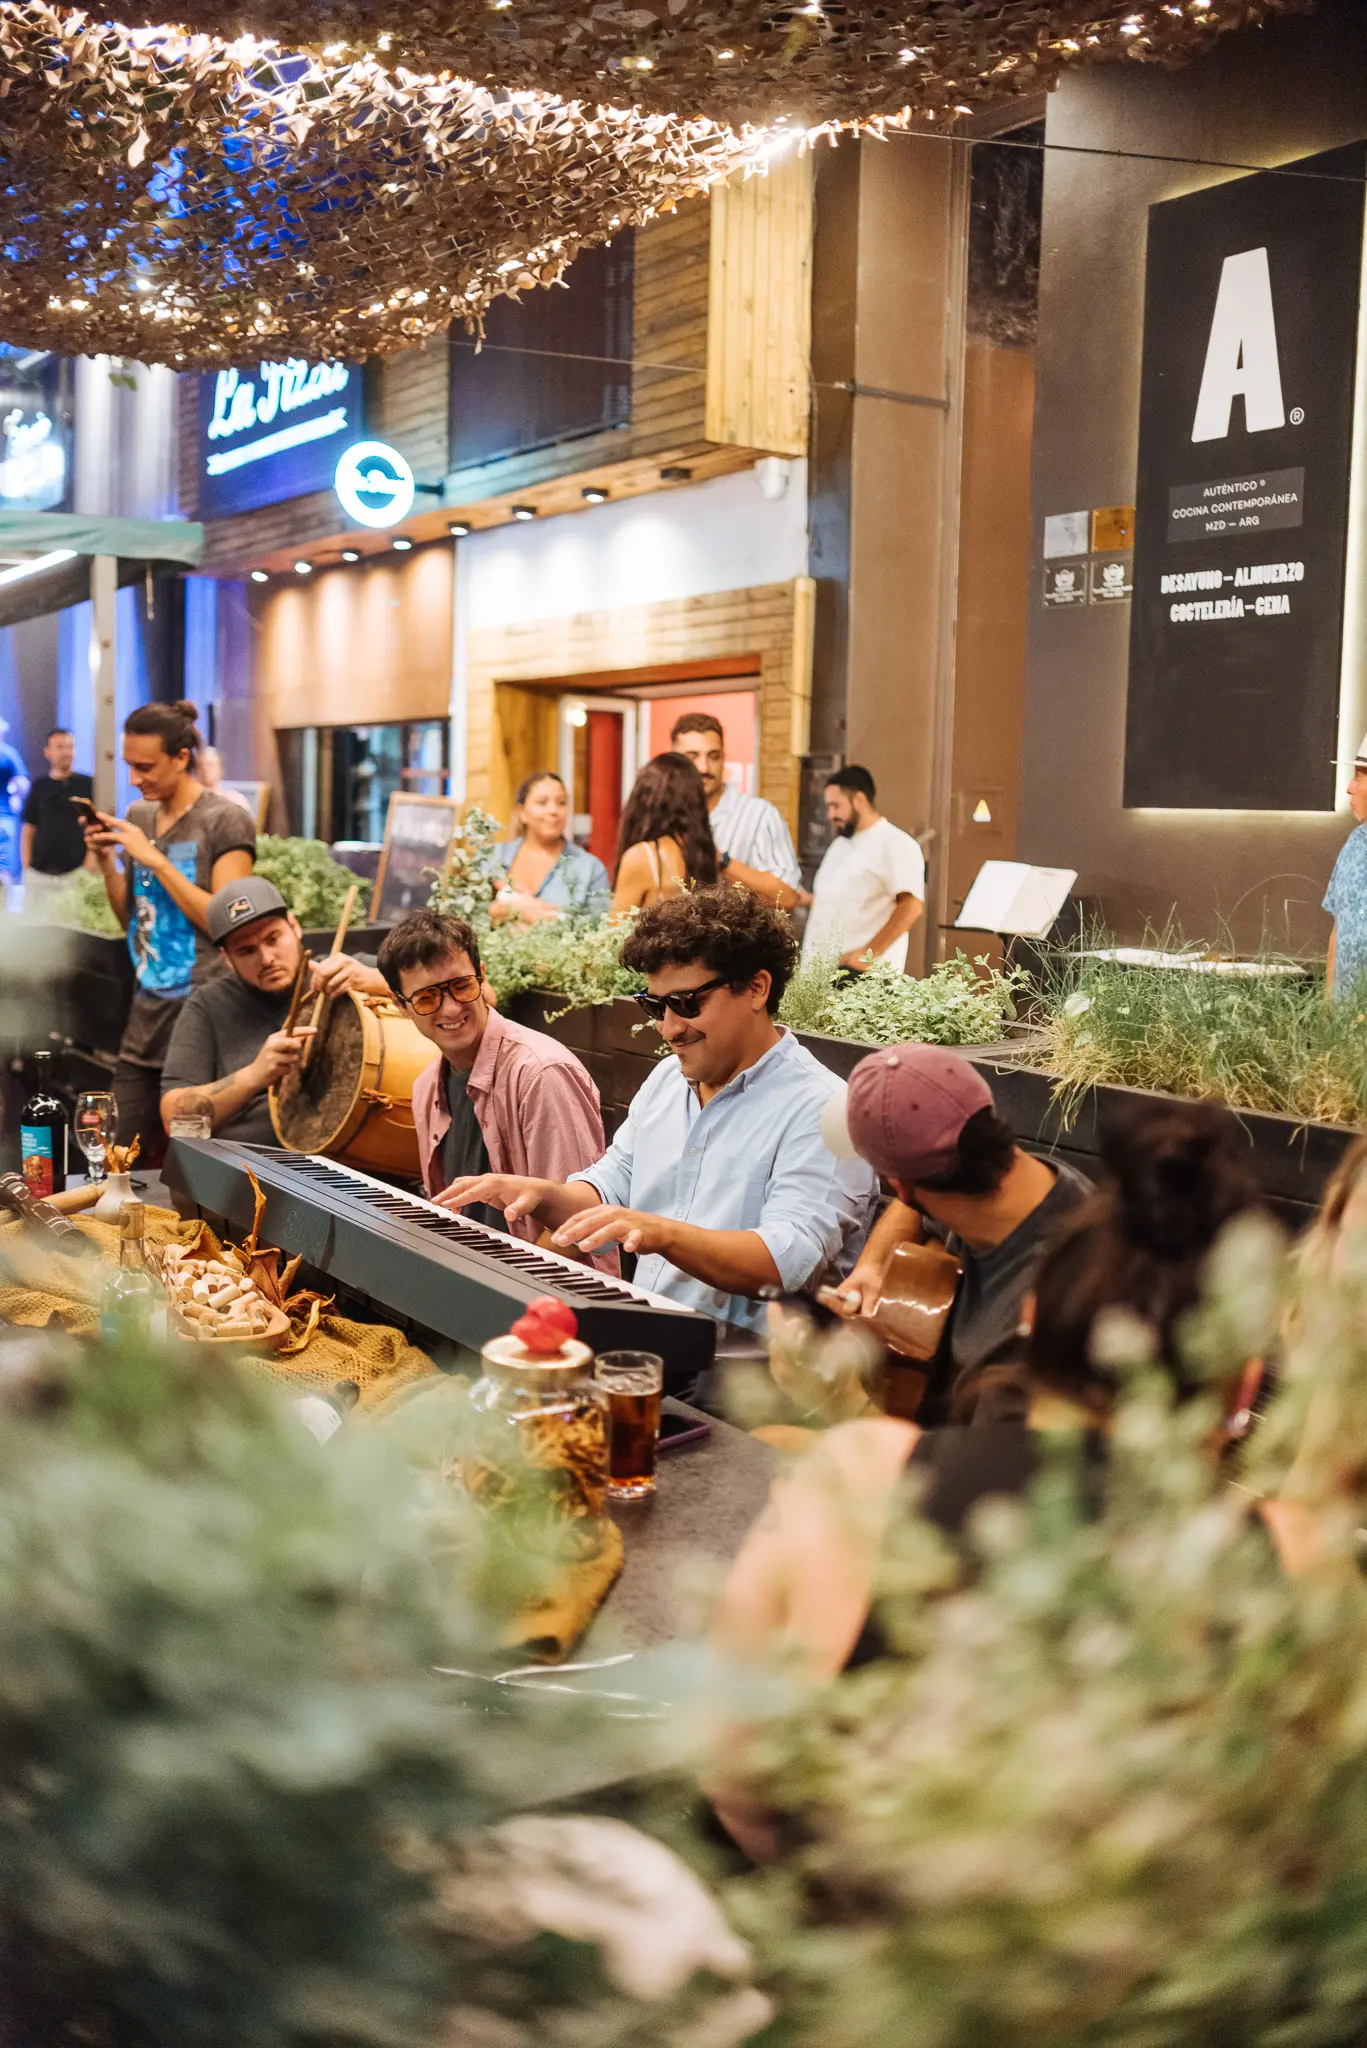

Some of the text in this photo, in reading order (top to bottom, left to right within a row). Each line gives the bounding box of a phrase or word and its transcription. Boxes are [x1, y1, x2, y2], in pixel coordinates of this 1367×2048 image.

[1191, 247, 1285, 443] A
[1203, 480, 1258, 498] AUTÉNTICO
[1172, 493, 1298, 519] COCINA CONTEMPORÁNEA
[1205, 520, 1226, 532] MZD
[1238, 515, 1260, 528] ARG
